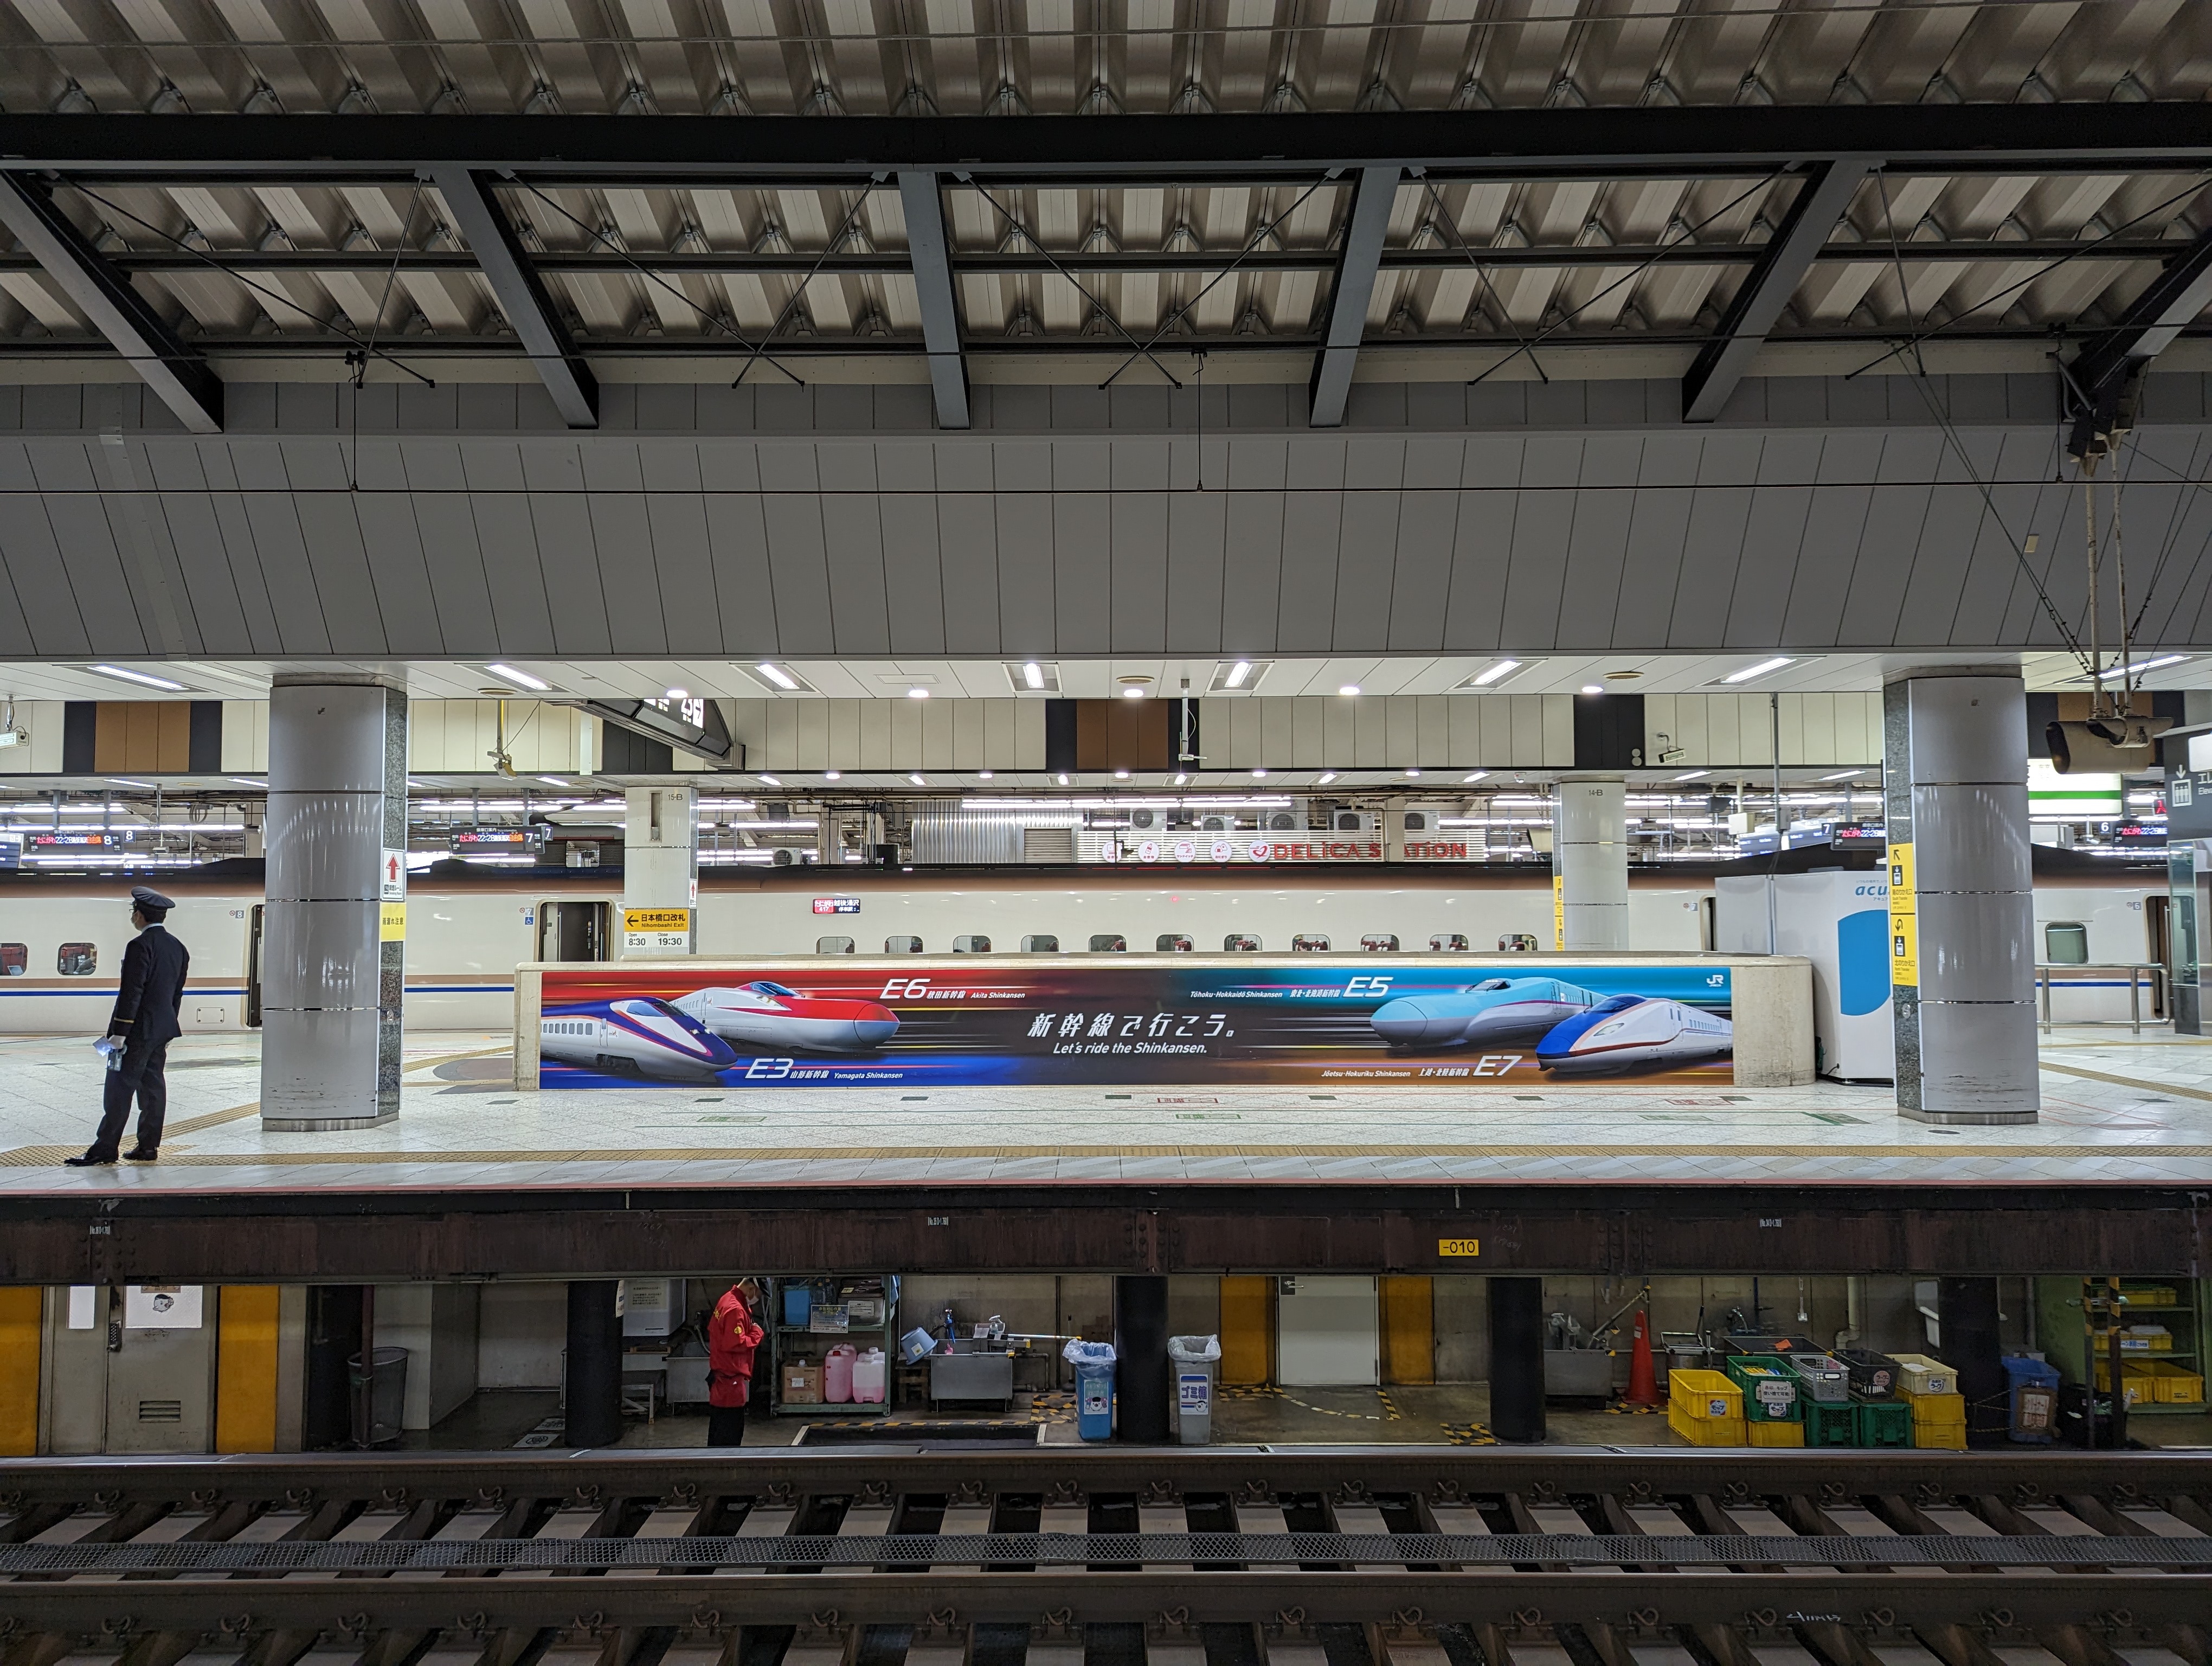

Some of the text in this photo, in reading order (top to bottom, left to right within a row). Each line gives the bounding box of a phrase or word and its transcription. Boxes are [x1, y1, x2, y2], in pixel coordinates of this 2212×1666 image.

[1824, 824, 1830, 834] 7
[2101, 822, 2109, 832] 6
[126, 830, 133, 840] 8
[525, 833, 533, 843] 7
[545, 828, 551, 838] 7
[104, 835, 112, 845] 8
[641, 913, 686, 922] 日本橋口改札
[628, 937, 682, 946] 8:30 19:30
[1706, 975, 1724, 984] JR
[879, 978, 931, 999] E6
[926, 990, 966, 999] 秋田新幹線
[1342, 977, 1394, 998] E5
[1027, 1013, 1235, 1037] 新幹線で行こう。
[1053, 1042, 1208, 1054] Let's ride the Shinkansen.
[744, 1058, 794, 1079] E3
[789, 1070, 830, 1079] 山形新幹線
[834, 1072, 865, 1080] Yamagata
[1472, 1055, 1523, 1077] E7
[1443, 1241, 1475, 1253] -010
[1181, 1385, 1207, 1400] ゴミ箱
